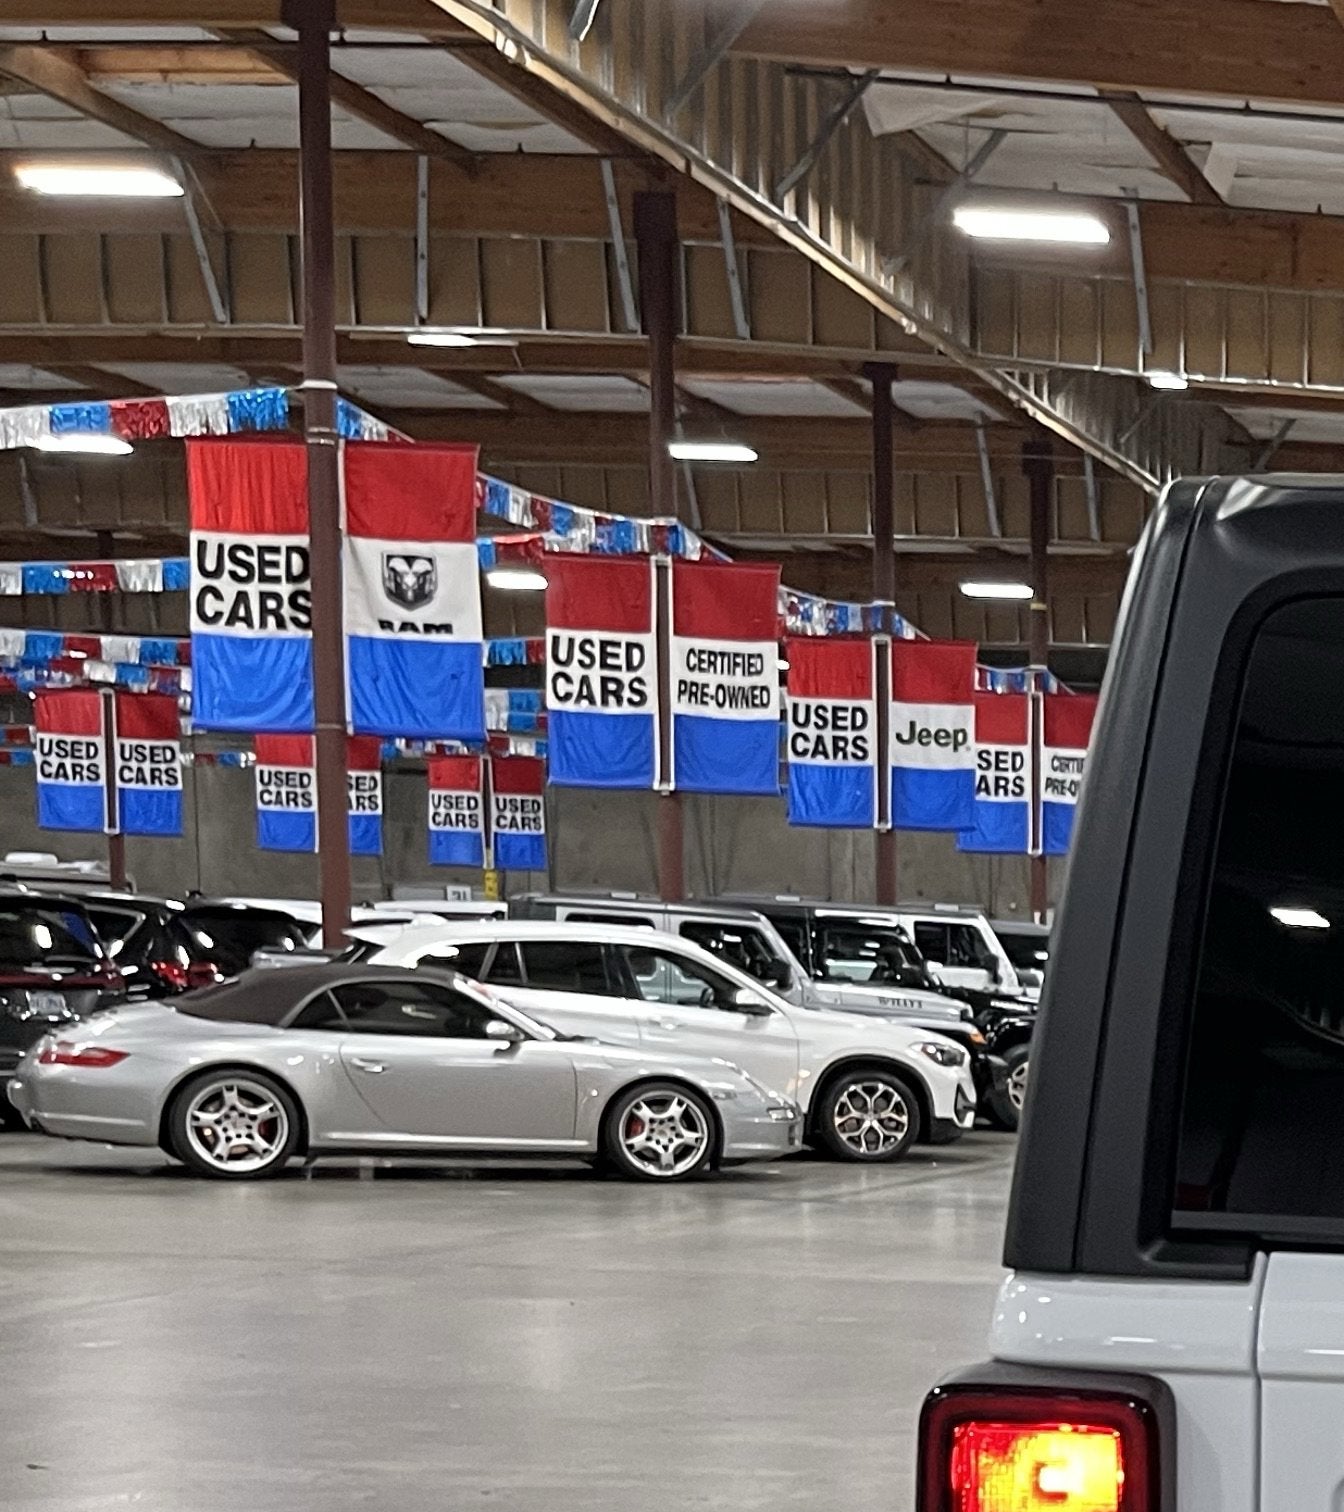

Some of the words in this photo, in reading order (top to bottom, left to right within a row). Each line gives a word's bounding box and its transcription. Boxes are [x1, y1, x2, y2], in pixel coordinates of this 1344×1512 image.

[197, 539, 311, 585] USED
[196, 584, 312, 631] CARS
[551, 635, 645, 672] USED
[686, 648, 764, 677] CERTIFIED
[551, 671, 648, 708] CARS
[677, 679, 771, 709] PRE-OWNED
[792, 702, 869, 732] USED
[790, 732, 870, 762] CARS
[895, 720, 968, 753] Jeep
[39, 737, 99, 760] USED
[119, 742, 177, 764] USED
[40, 760, 100, 781] CARS
[977, 749, 1024, 772] SED
[118, 765, 179, 786] CARS
[259, 769, 312, 789] USED
[975, 774, 1025, 797] ARS
[259, 788, 313, 808] CARS
[431, 793, 479, 811] USED
[495, 796, 541, 814] USED
[431, 811, 479, 829] CARS
[495, 814, 542, 831] CARS
